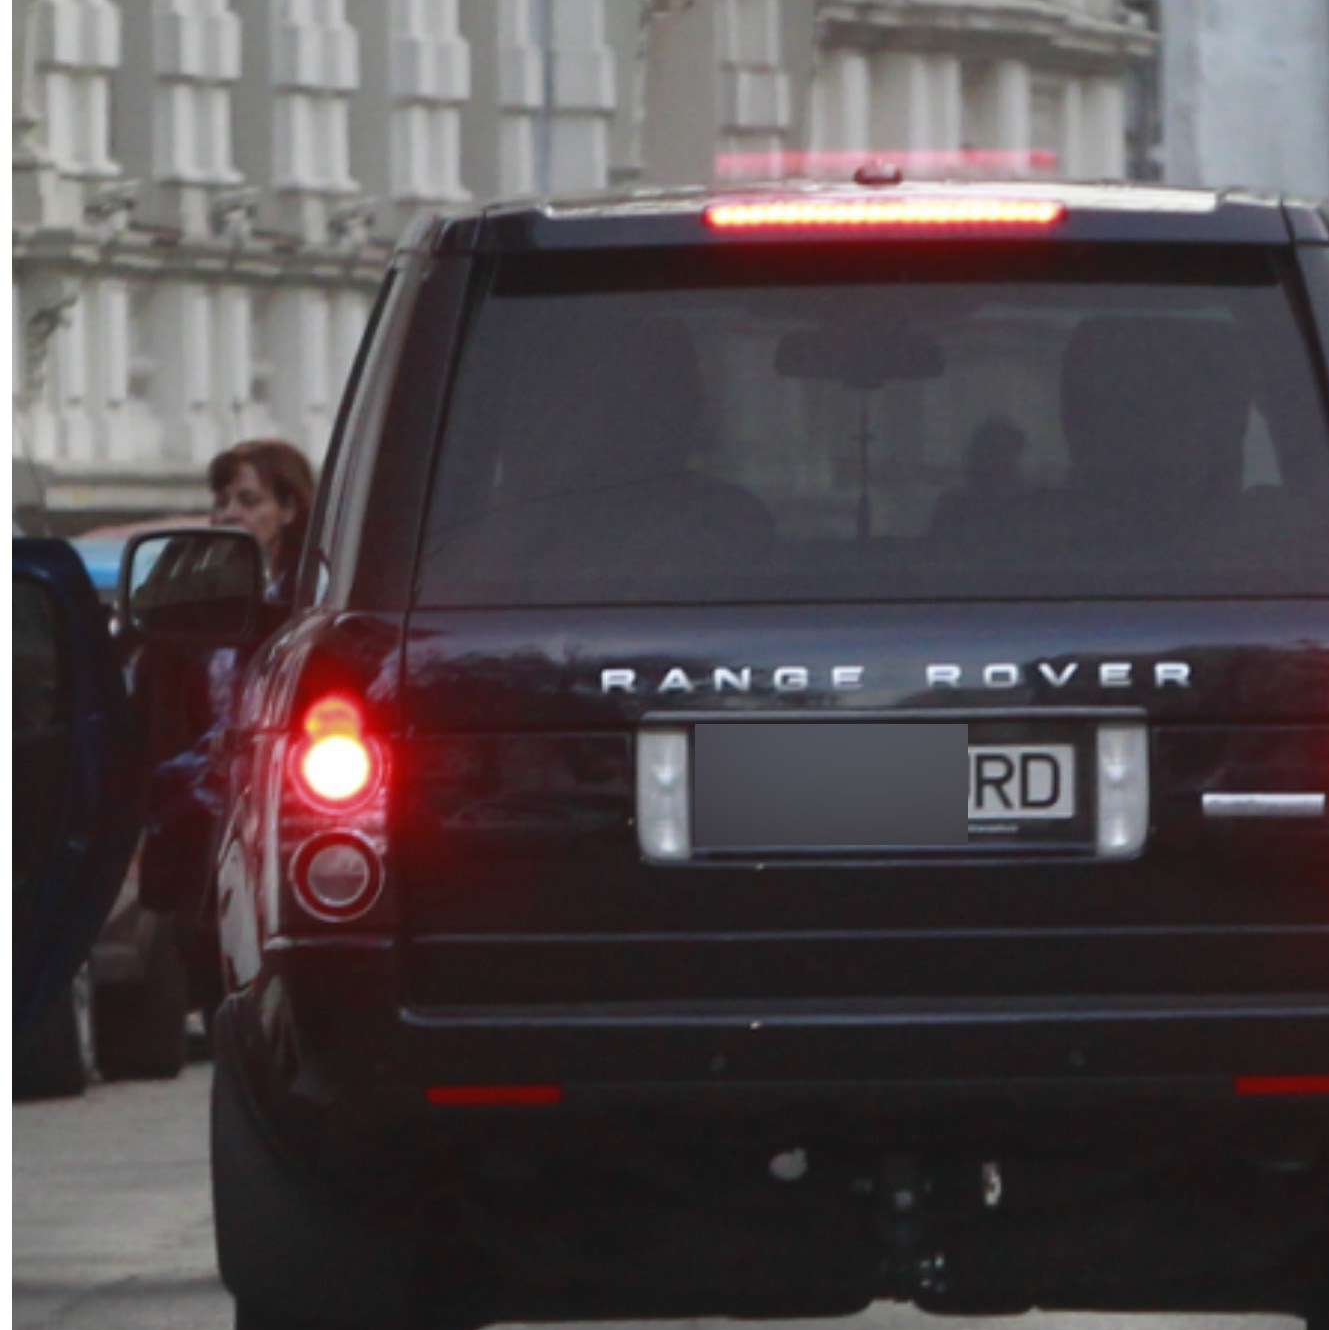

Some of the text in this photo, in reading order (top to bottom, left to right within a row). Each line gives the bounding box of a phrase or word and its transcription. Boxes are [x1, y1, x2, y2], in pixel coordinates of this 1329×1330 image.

[601, 661, 1192, 695] RANGE ROVER
[967, 752, 1061, 810] RD
